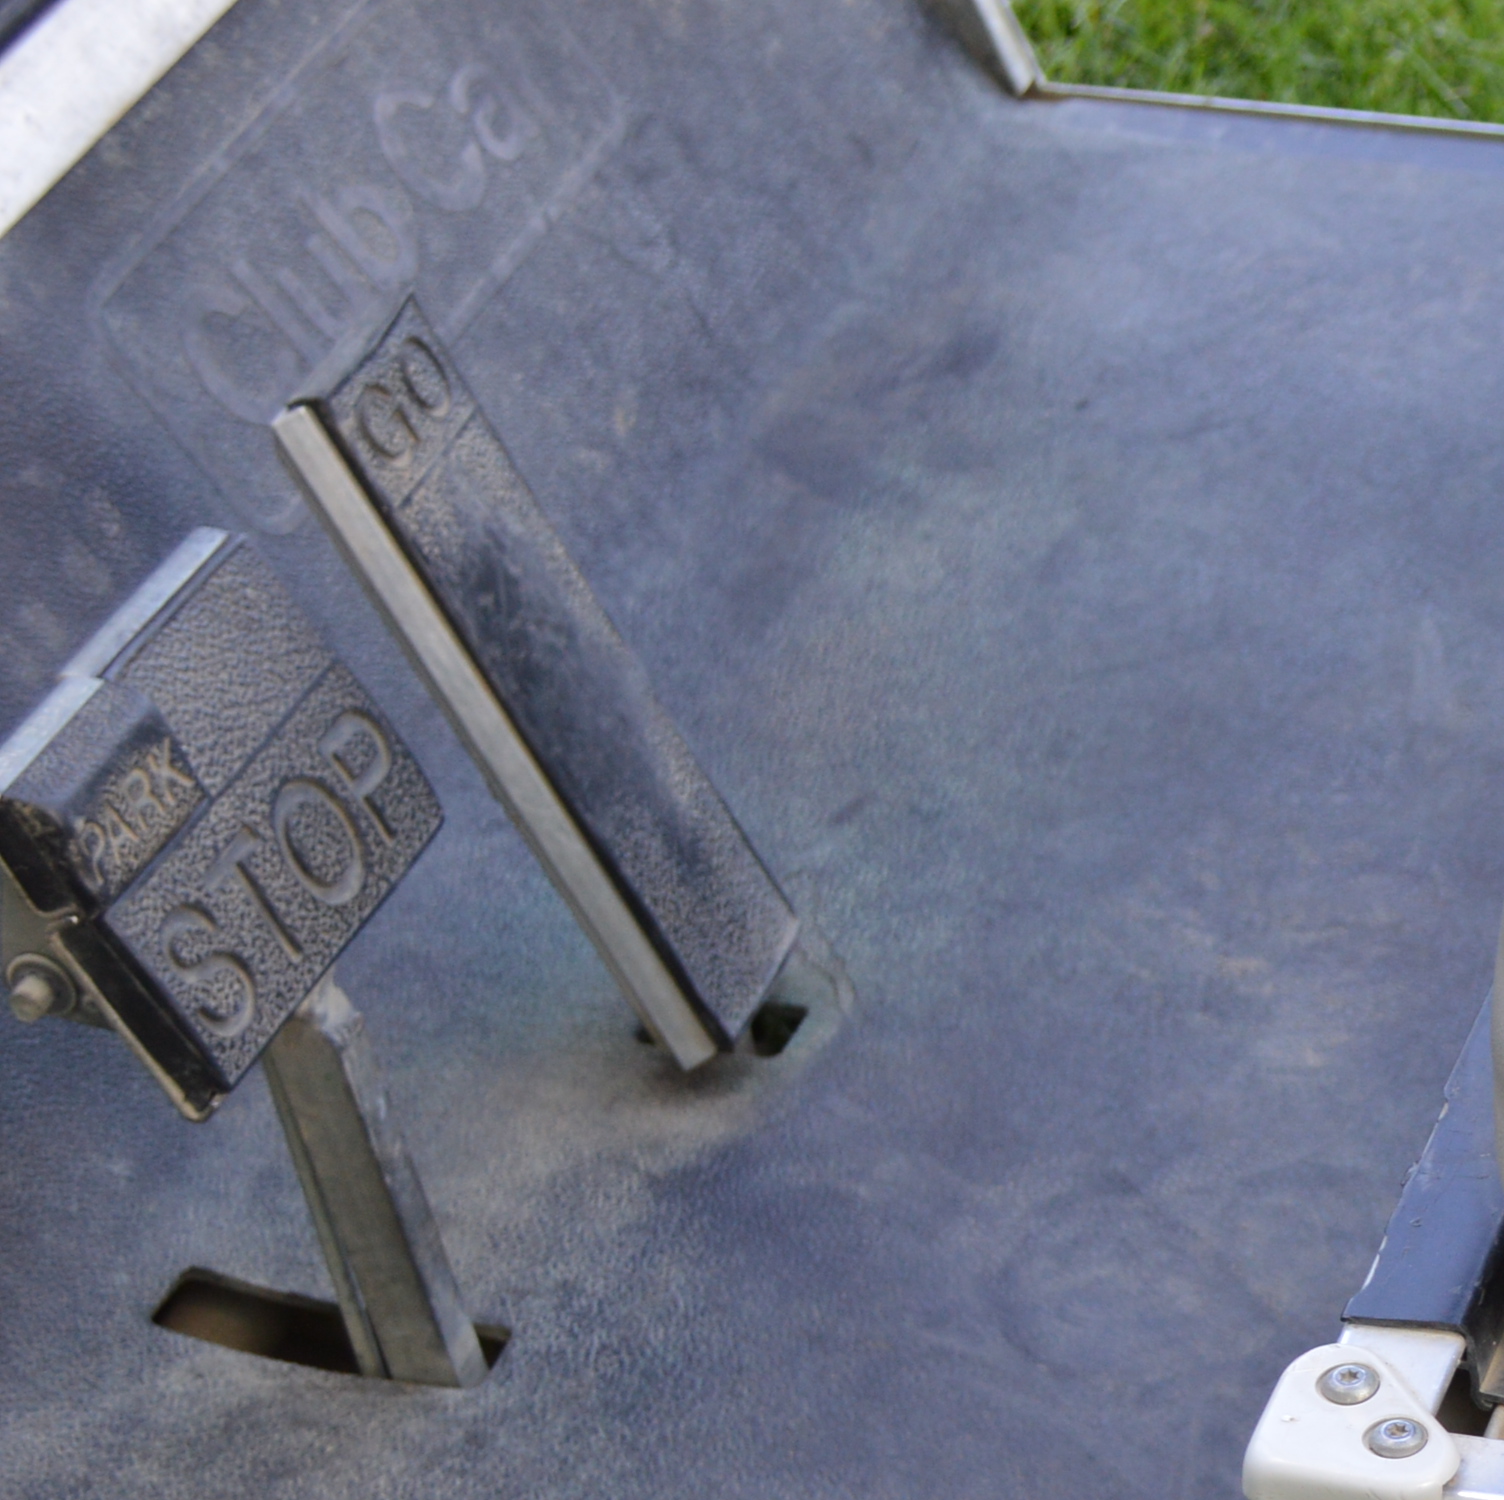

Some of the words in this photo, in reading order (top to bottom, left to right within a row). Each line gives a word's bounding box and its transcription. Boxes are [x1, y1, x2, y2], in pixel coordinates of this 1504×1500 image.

[181, 185, 418, 425] Club
[353, 334, 452, 469] GO
[76, 737, 195, 885] PARK
[161, 710, 396, 1038] STOP
